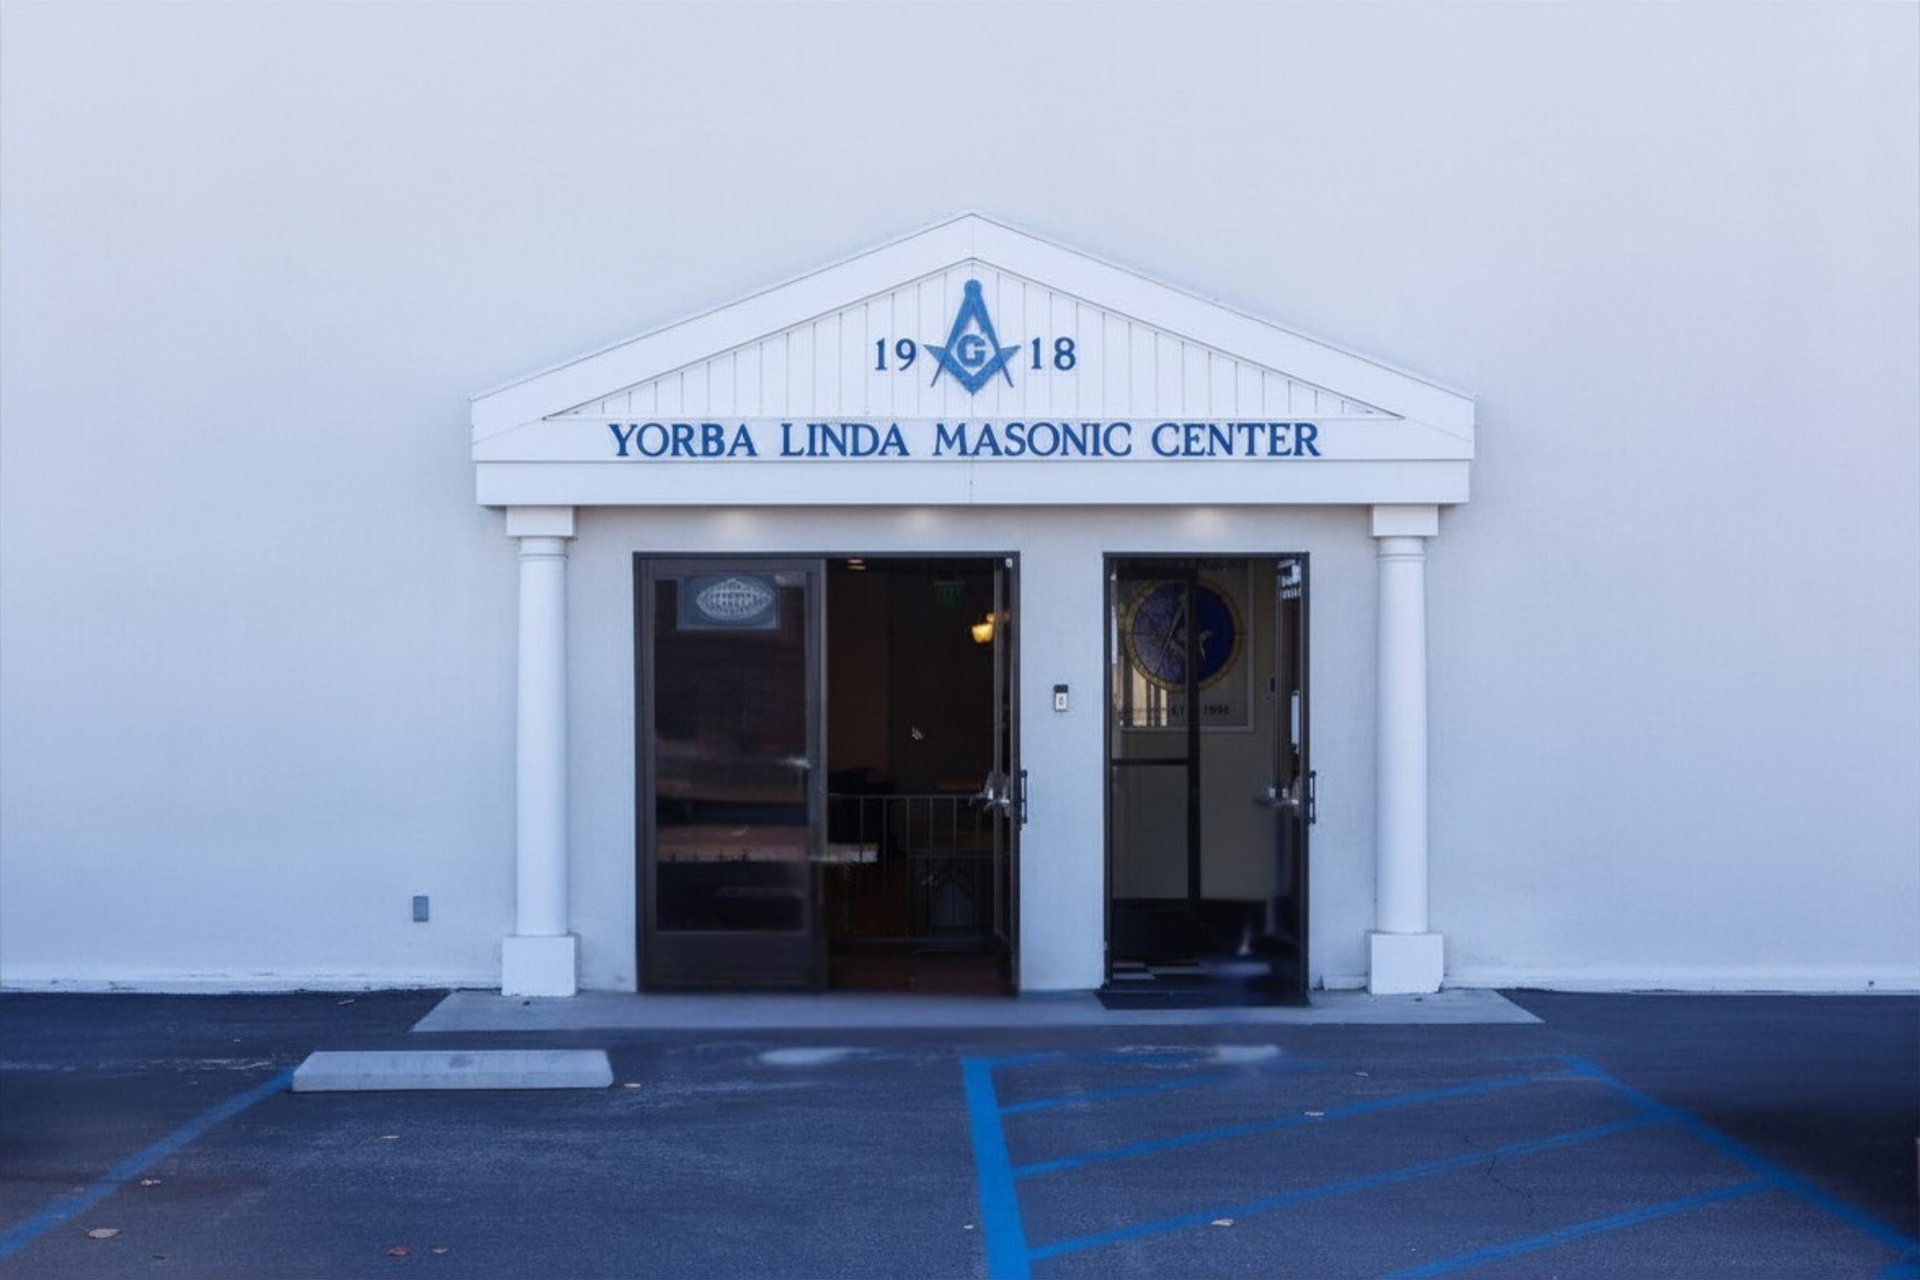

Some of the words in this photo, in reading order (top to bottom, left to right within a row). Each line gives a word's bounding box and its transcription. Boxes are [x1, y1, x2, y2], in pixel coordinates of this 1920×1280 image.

[876, 338, 917, 371] 19
[957, 334, 986, 367] G
[1032, 337, 1077, 371] 18
[608, 422, 759, 458] YORBA
[780, 422, 911, 458] LINDA
[932, 422, 1133, 458] MASONIC
[1151, 422, 1322, 458] CENTER
